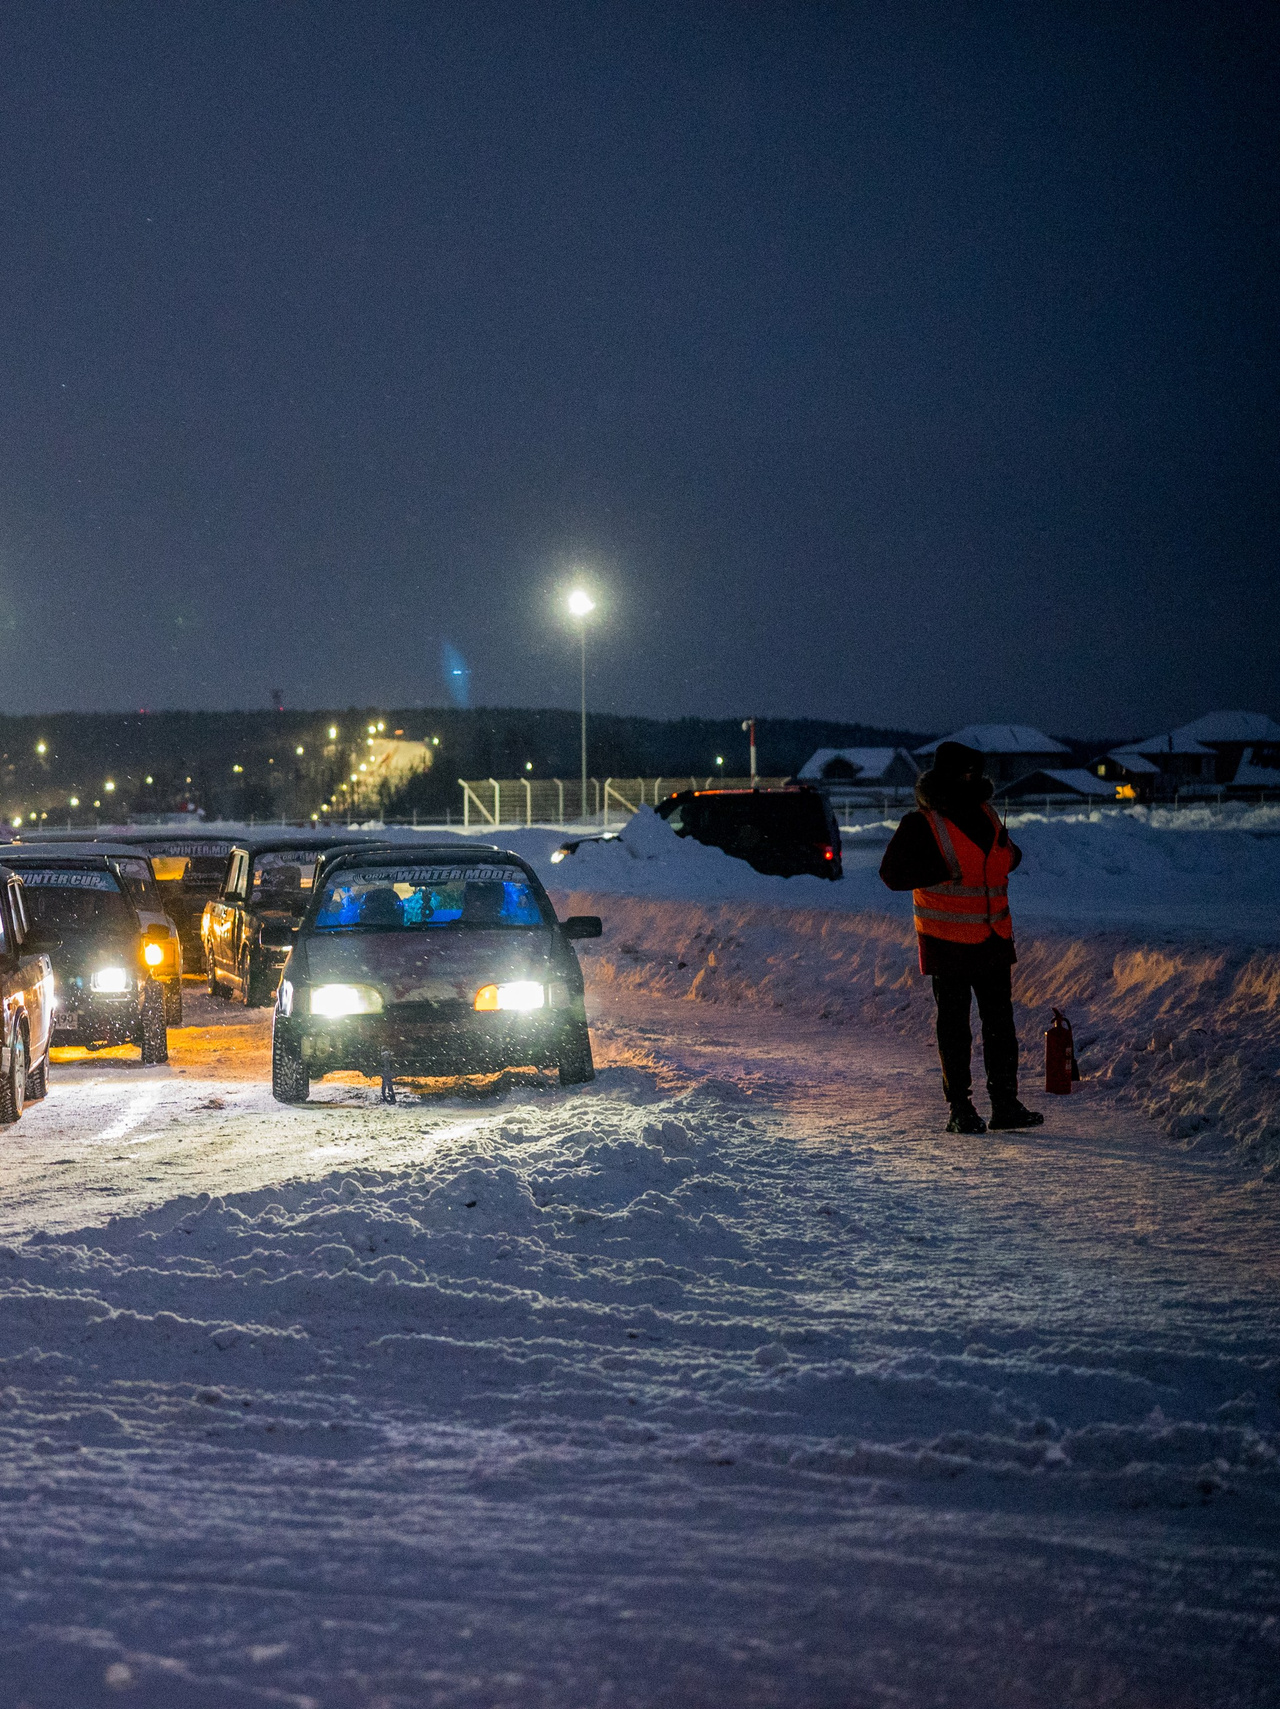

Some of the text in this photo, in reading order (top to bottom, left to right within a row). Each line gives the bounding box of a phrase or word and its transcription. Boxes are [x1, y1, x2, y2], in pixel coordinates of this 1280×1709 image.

[70, 875, 100, 886] CUP
[395, 870, 463, 881] WINTER
[464, 869, 513, 880] MODE
